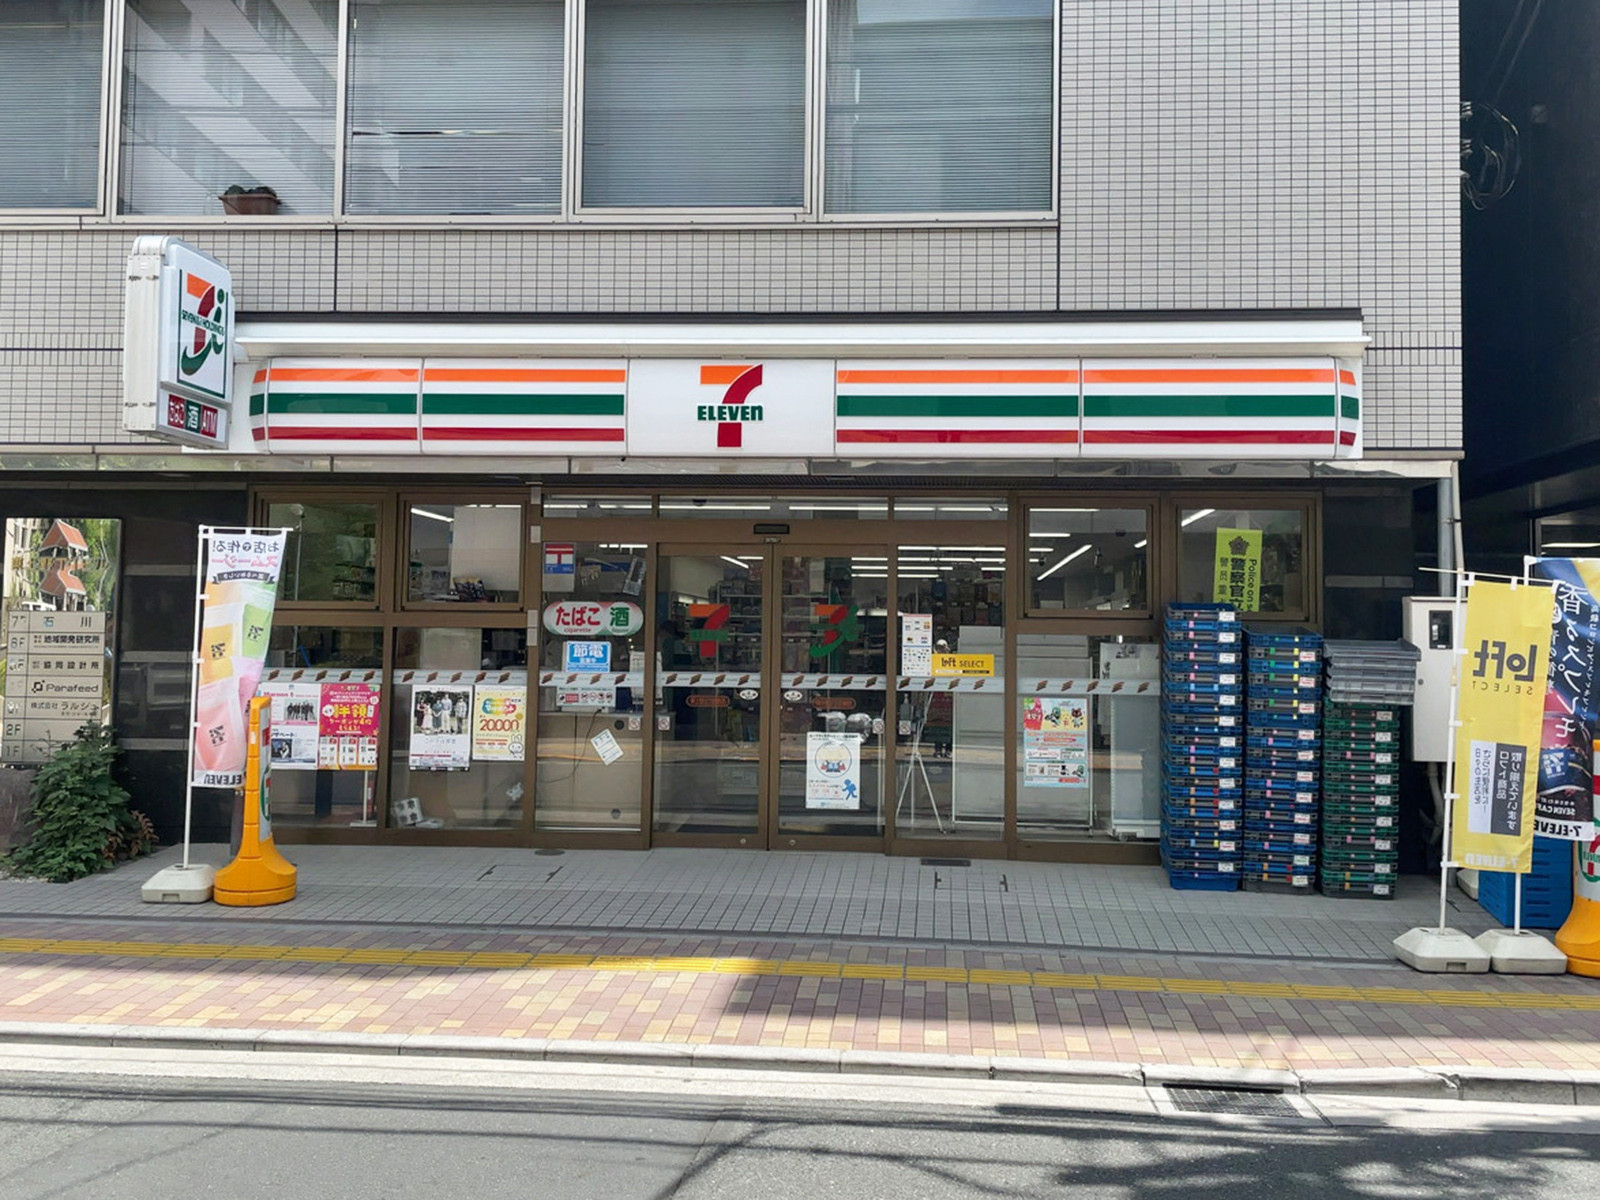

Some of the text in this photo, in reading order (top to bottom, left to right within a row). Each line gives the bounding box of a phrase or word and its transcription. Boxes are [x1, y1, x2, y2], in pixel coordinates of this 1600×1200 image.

[200, 409, 218, 434] ATM
[1248, 559, 1258, 589] Police
[1246, 589, 1255, 602] on
[555, 606, 630, 627] たばこ 酒
[573, 643, 604, 658] 節電
[959, 660, 985, 668] SELECT
[45, 683, 99, 693] Parafeed
[6, 723, 22, 736] 2F
[6, 745, 21, 757] 1F
